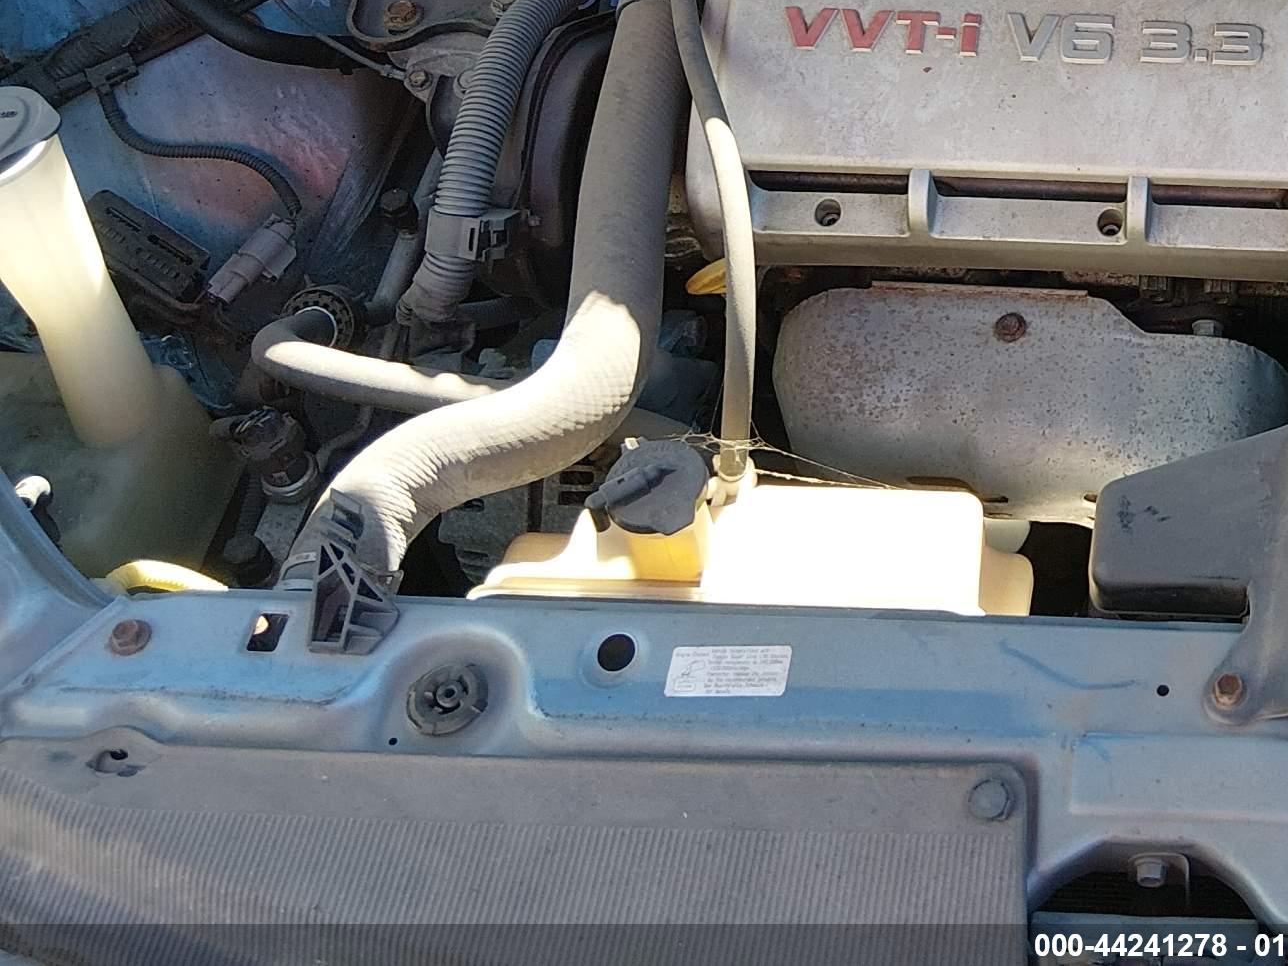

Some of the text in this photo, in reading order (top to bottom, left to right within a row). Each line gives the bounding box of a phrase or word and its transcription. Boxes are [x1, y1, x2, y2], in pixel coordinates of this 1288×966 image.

[785, 6, 1264, 66] VVT-i V6 3.3
